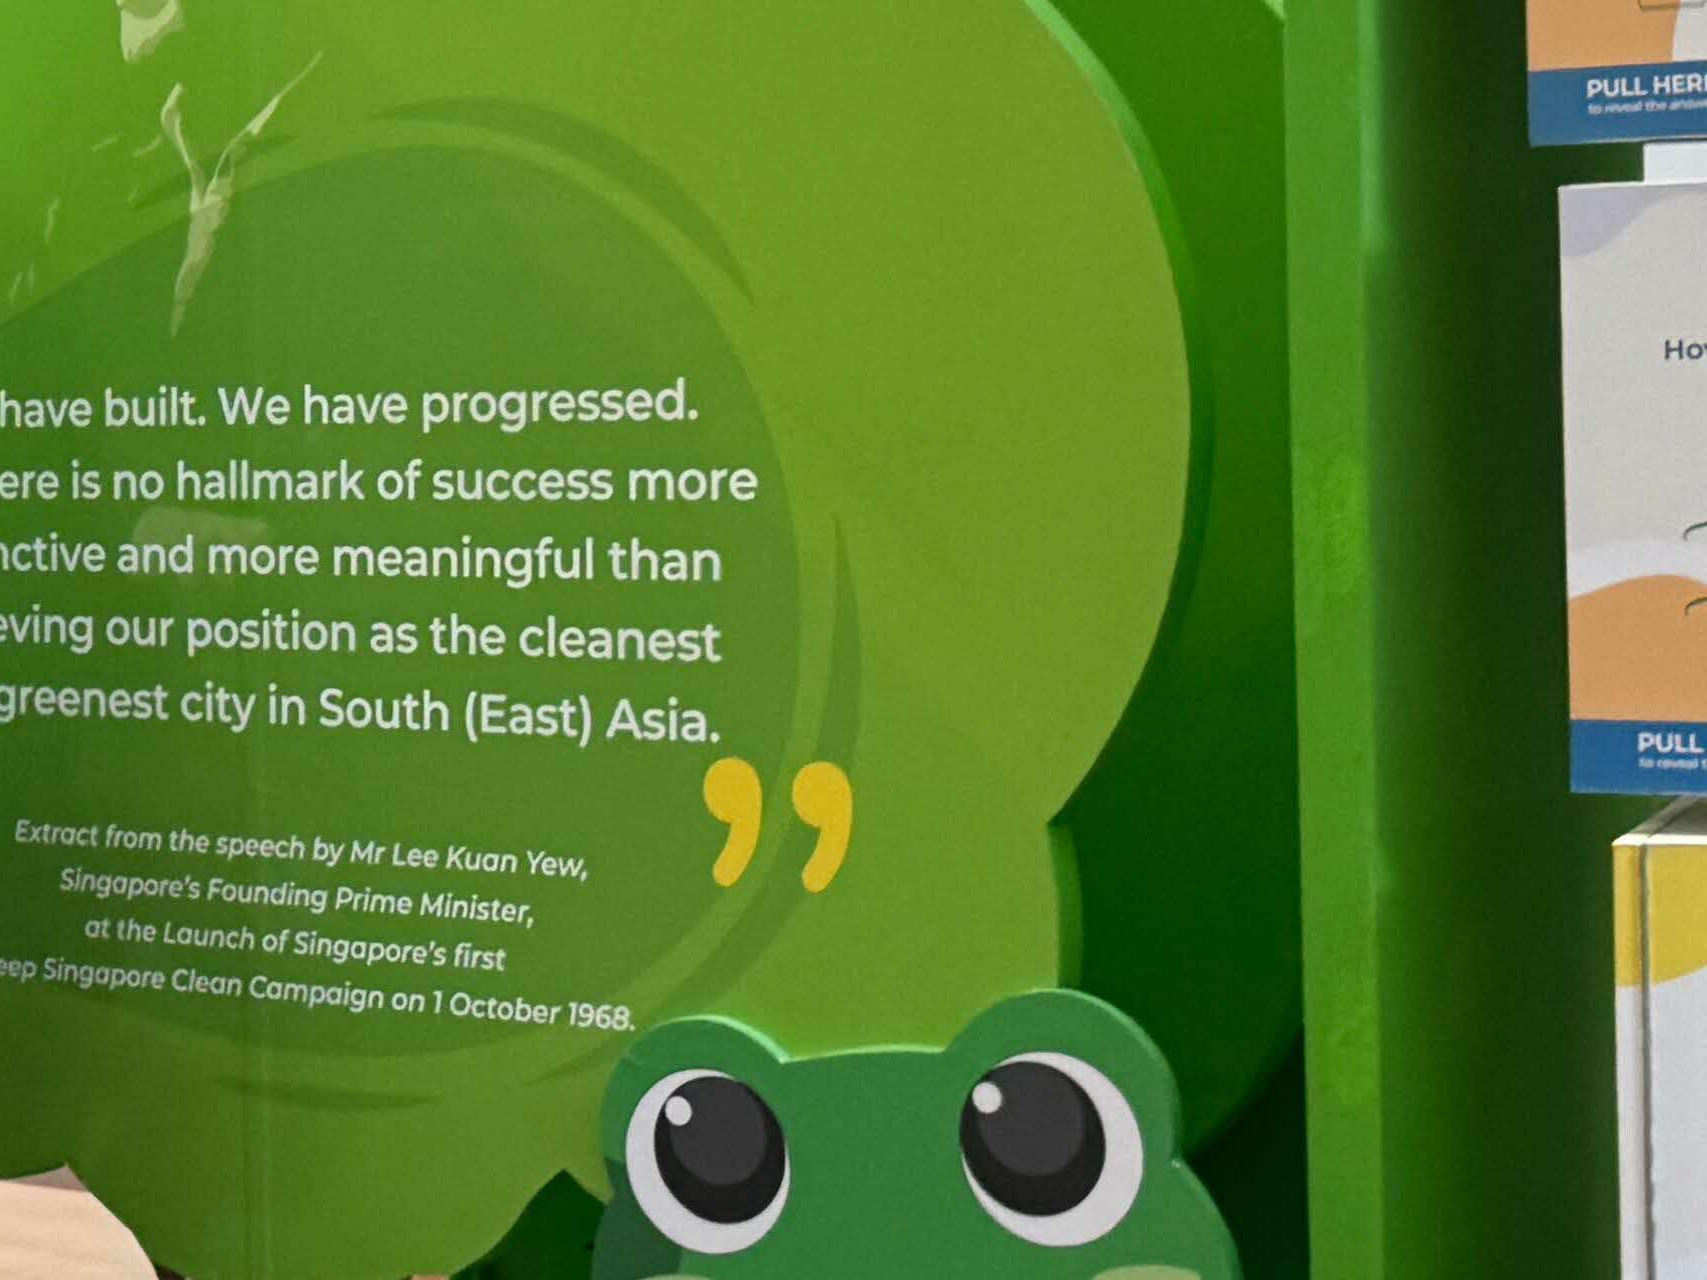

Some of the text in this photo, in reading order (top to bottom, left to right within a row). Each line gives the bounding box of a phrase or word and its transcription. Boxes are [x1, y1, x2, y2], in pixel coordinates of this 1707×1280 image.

[1587, 77, 1648, 98] PULL
[0, 389, 91, 427] have
[105, 385, 206, 426] built.
[218, 386, 290, 424] We
[304, 384, 408, 424] have
[422, 377, 698, 433] progressed.
[71, 459, 100, 499] is
[113, 471, 164, 500] no
[177, 459, 364, 500] hallmark
[377, 458, 422, 500] of
[432, 469, 613, 500] success
[629, 468, 757, 500] more
[117, 534, 193, 573] and
[208, 544, 319, 575] more
[333, 535, 593, 589] meaningful
[608, 537, 720, 580] than
[106, 616, 174, 646] our
[187, 608, 355, 657] position
[370, 622, 417, 653] as
[429, 613, 505, 655] the
[519, 615, 721, 662] cleanest
[180, 680, 256, 732] city
[268, 682, 306, 725] in
[319, 688, 448, 730] South
[465, 691, 591, 748] (East)
[606, 696, 719, 742] Asia.
[1638, 732, 1705, 753] PULL
[15, 819, 587, 881] Extract from the speech by Mr Lee Kuan Yew,
[60, 867, 533, 928] Singapore's Founding Prime Minister,
[85, 918, 506, 971] at the Launch of Singapore's first
[43, 957, 165, 989] Singapore
[171, 968, 242, 996] Clean
[248, 975, 384, 1012] Campaign
[391, 992, 425, 1012] on
[433, 990, 442, 1013] 1
[449, 992, 562, 1023] October
[568, 1001, 635, 1030] 1968.
